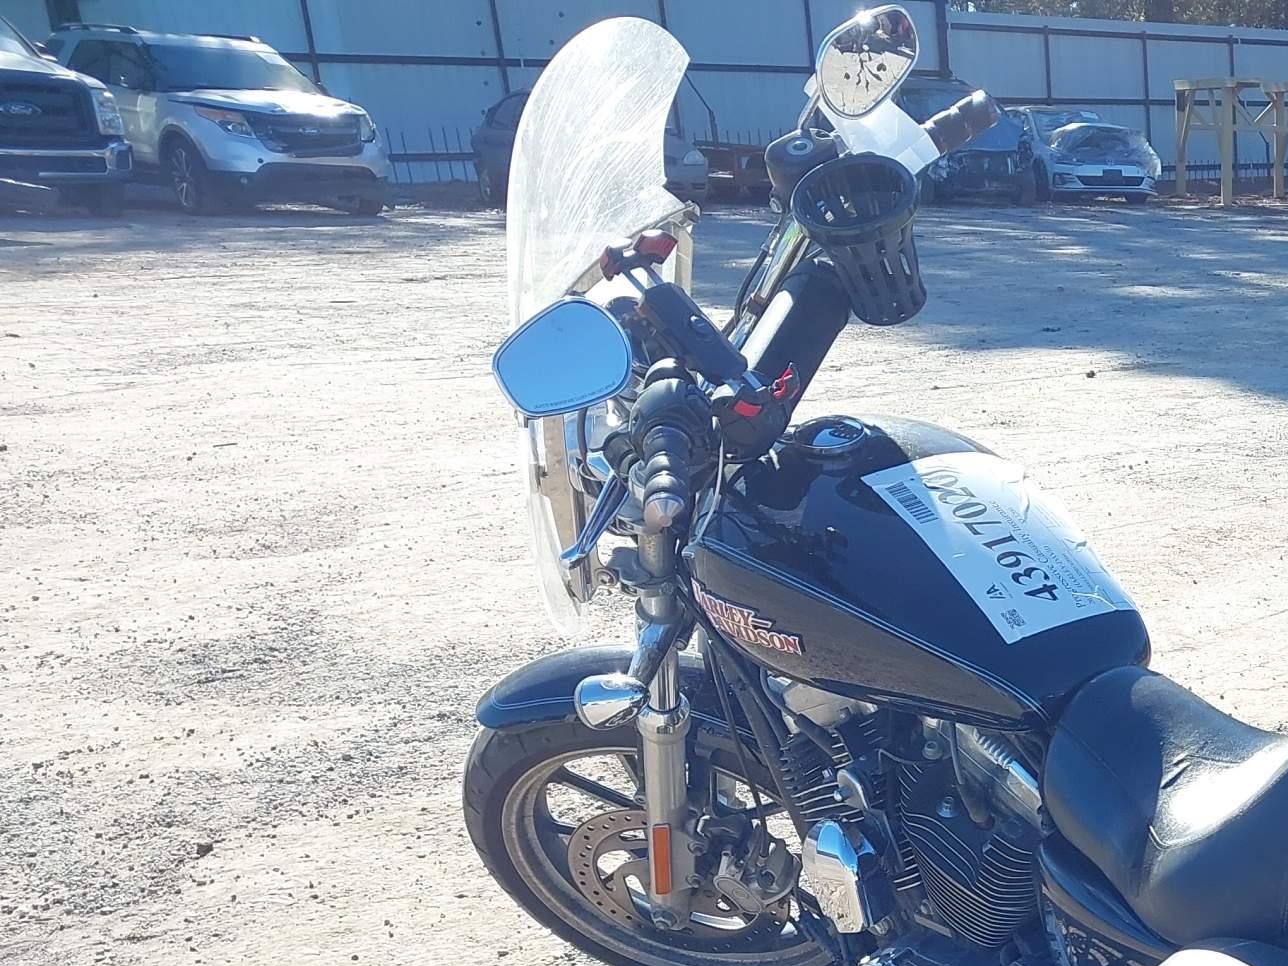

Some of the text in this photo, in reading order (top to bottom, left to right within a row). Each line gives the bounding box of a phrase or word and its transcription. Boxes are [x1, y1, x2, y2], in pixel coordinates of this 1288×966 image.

[921, 474, 1061, 602] 43917020
[1014, 530, 1049, 564] Casualty
[1045, 562, 1087, 608] Progressive
